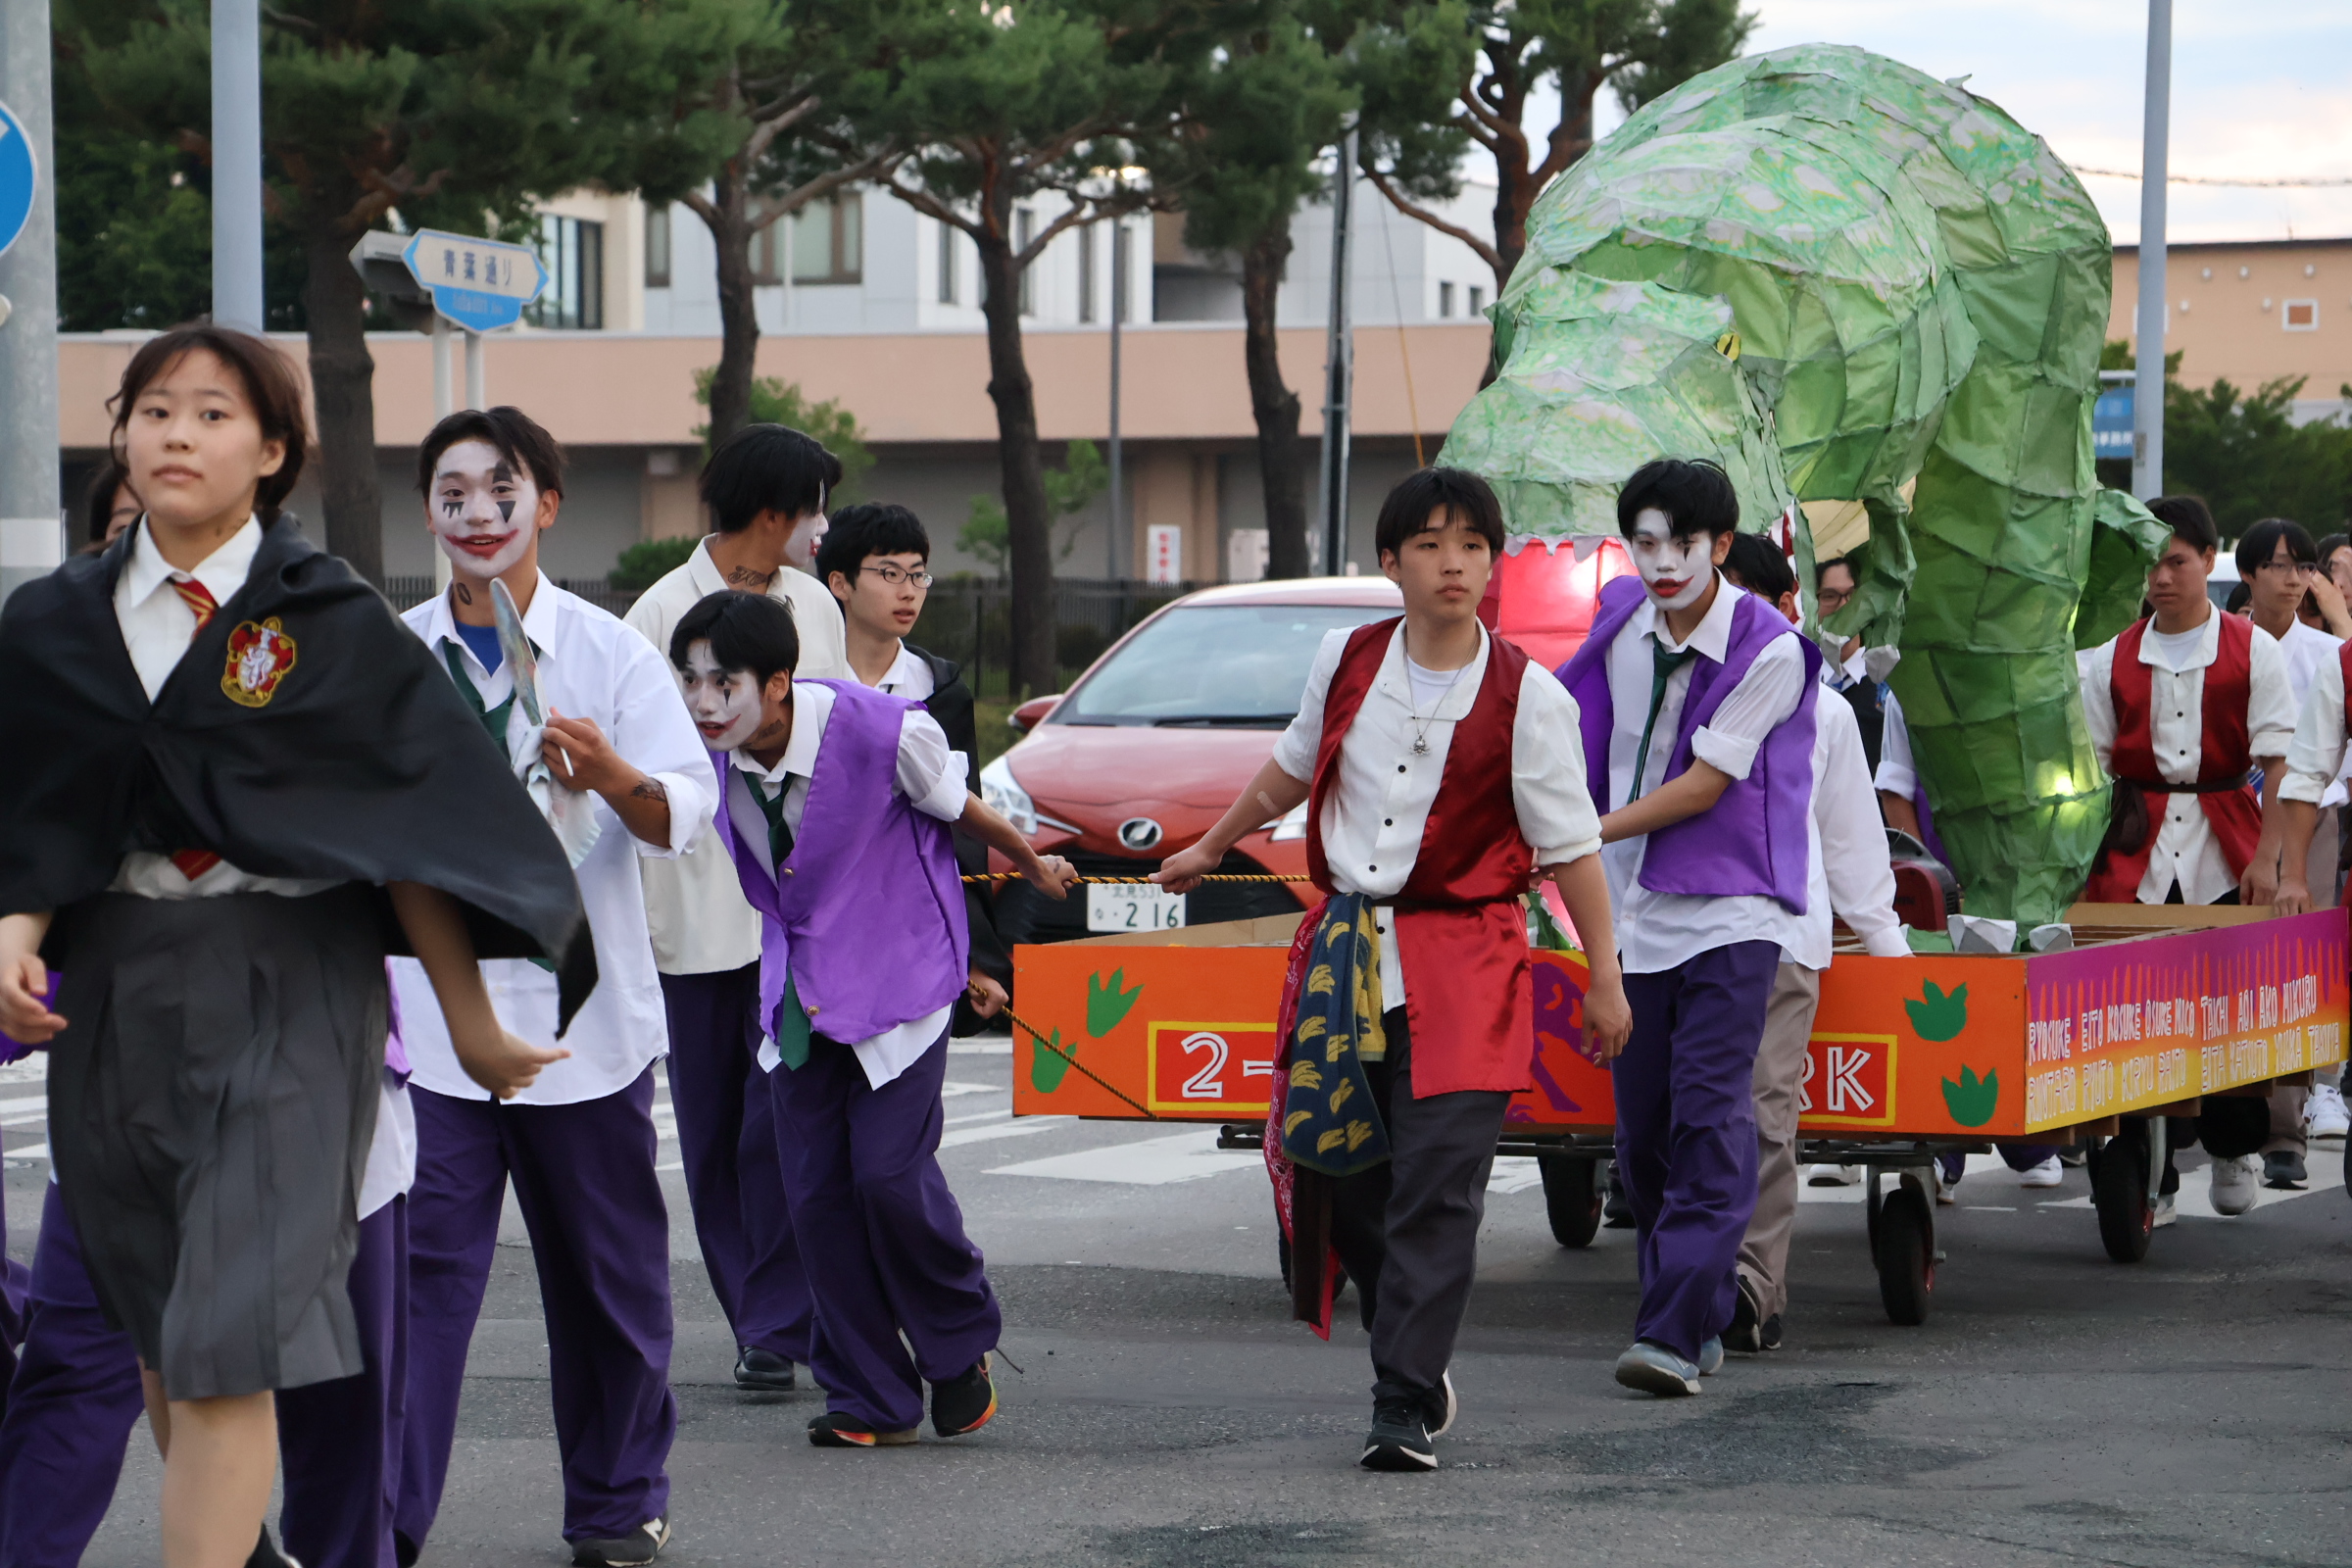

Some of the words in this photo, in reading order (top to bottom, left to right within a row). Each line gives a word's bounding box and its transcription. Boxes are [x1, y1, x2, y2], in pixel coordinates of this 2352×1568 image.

[443, 249, 512, 285] 青葉通り
[2029, 1017, 2071, 1066] RYOSUKE
[2082, 1008, 2103, 1052] EITO
[2107, 1003, 2141, 1043] KOSUKE
[2145, 999, 2172, 1039] OSUKE
[2201, 995, 2229, 1041] TAICHI
[2237, 989, 2254, 1032] AOI
[2259, 984, 2278, 1029] AKO
[2282, 974, 2317, 1024] MIKURU
[2028, 1066, 2076, 1124] RINTARO
[2082, 1058, 2113, 1111] RYUTO
[2122, 1055, 2154, 1102] KIRYU
[2201, 1045, 2227, 1093] EITA
[2307, 1022, 2340, 1066] TAKUYA
